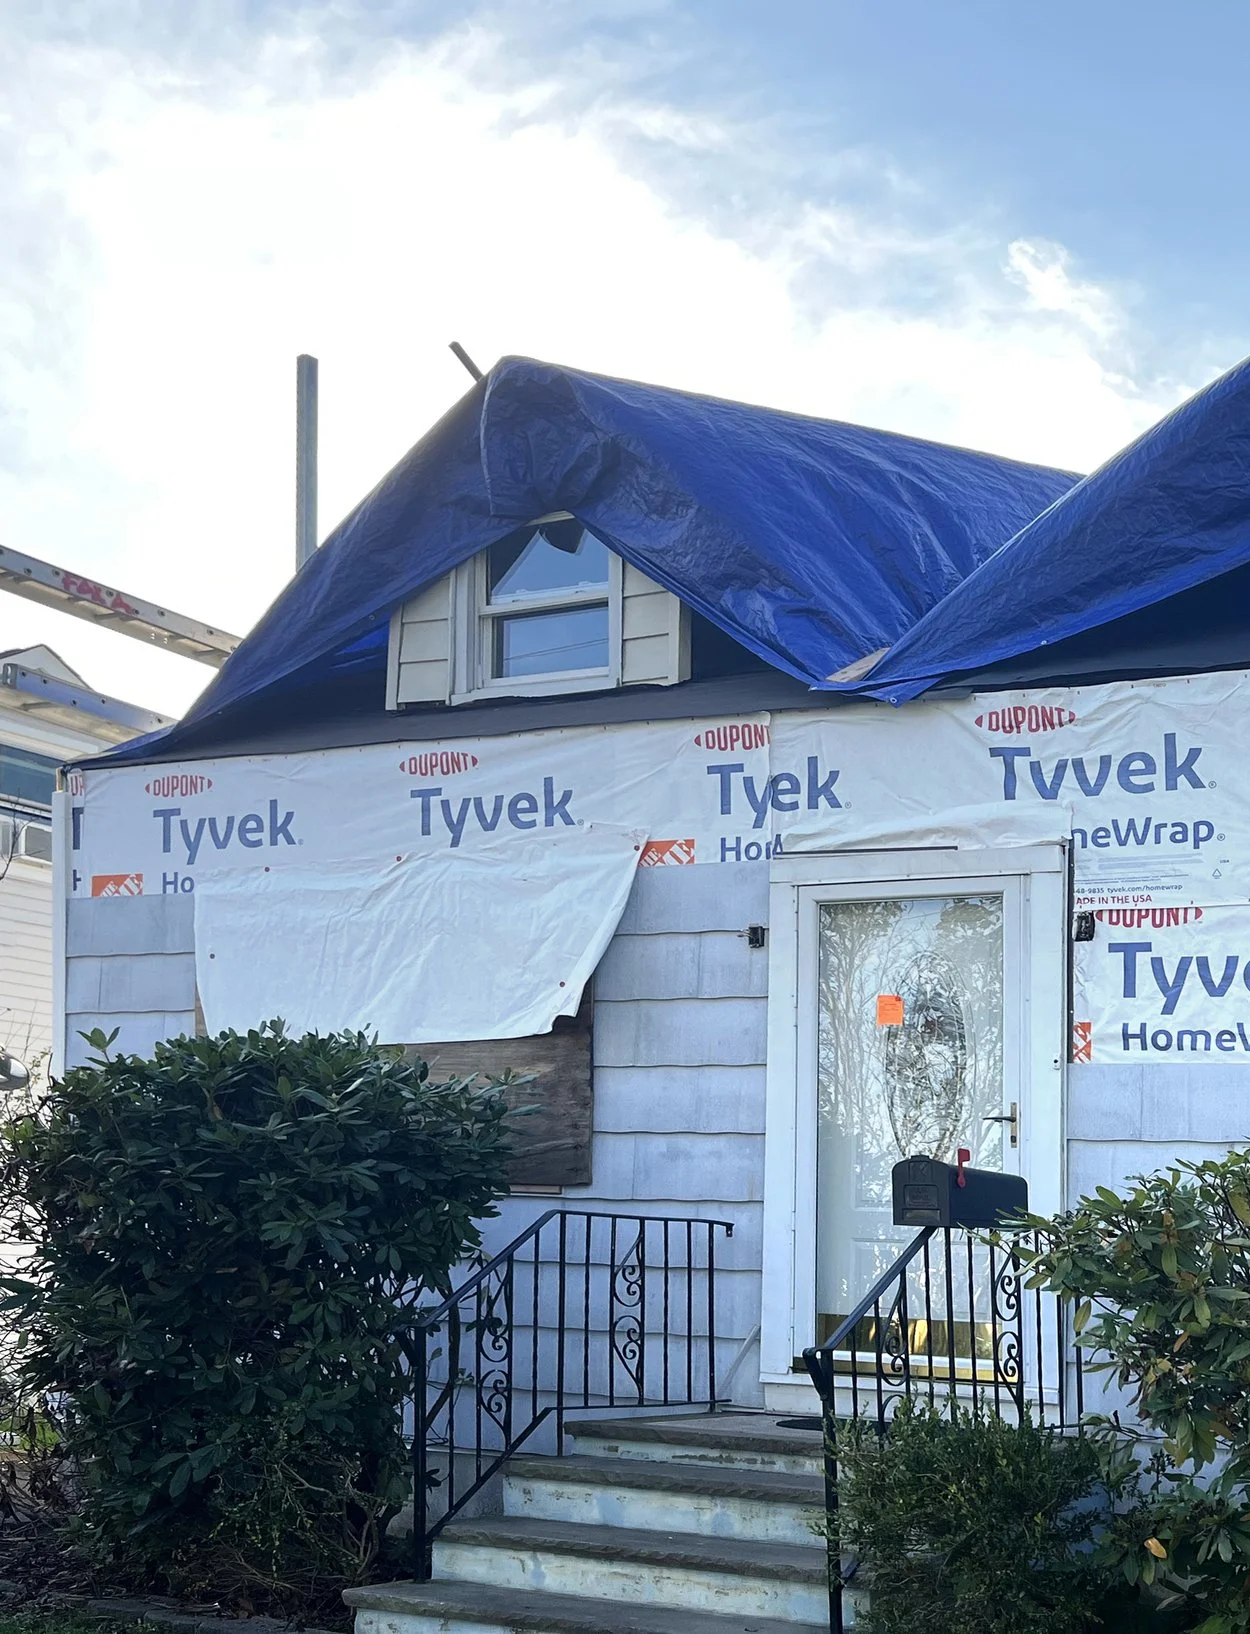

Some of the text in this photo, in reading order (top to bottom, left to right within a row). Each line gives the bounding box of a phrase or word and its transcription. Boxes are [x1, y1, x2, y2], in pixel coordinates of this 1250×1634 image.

[988, 704, 1066, 734] DUPONT
[409, 751, 470, 777] DUPONT
[153, 775, 206, 797] DUPONT
[410, 776, 576, 848] Tyvek
[153, 799, 297, 865] Tyvek
[1075, 894, 1153, 905] ADE IN THE USA
